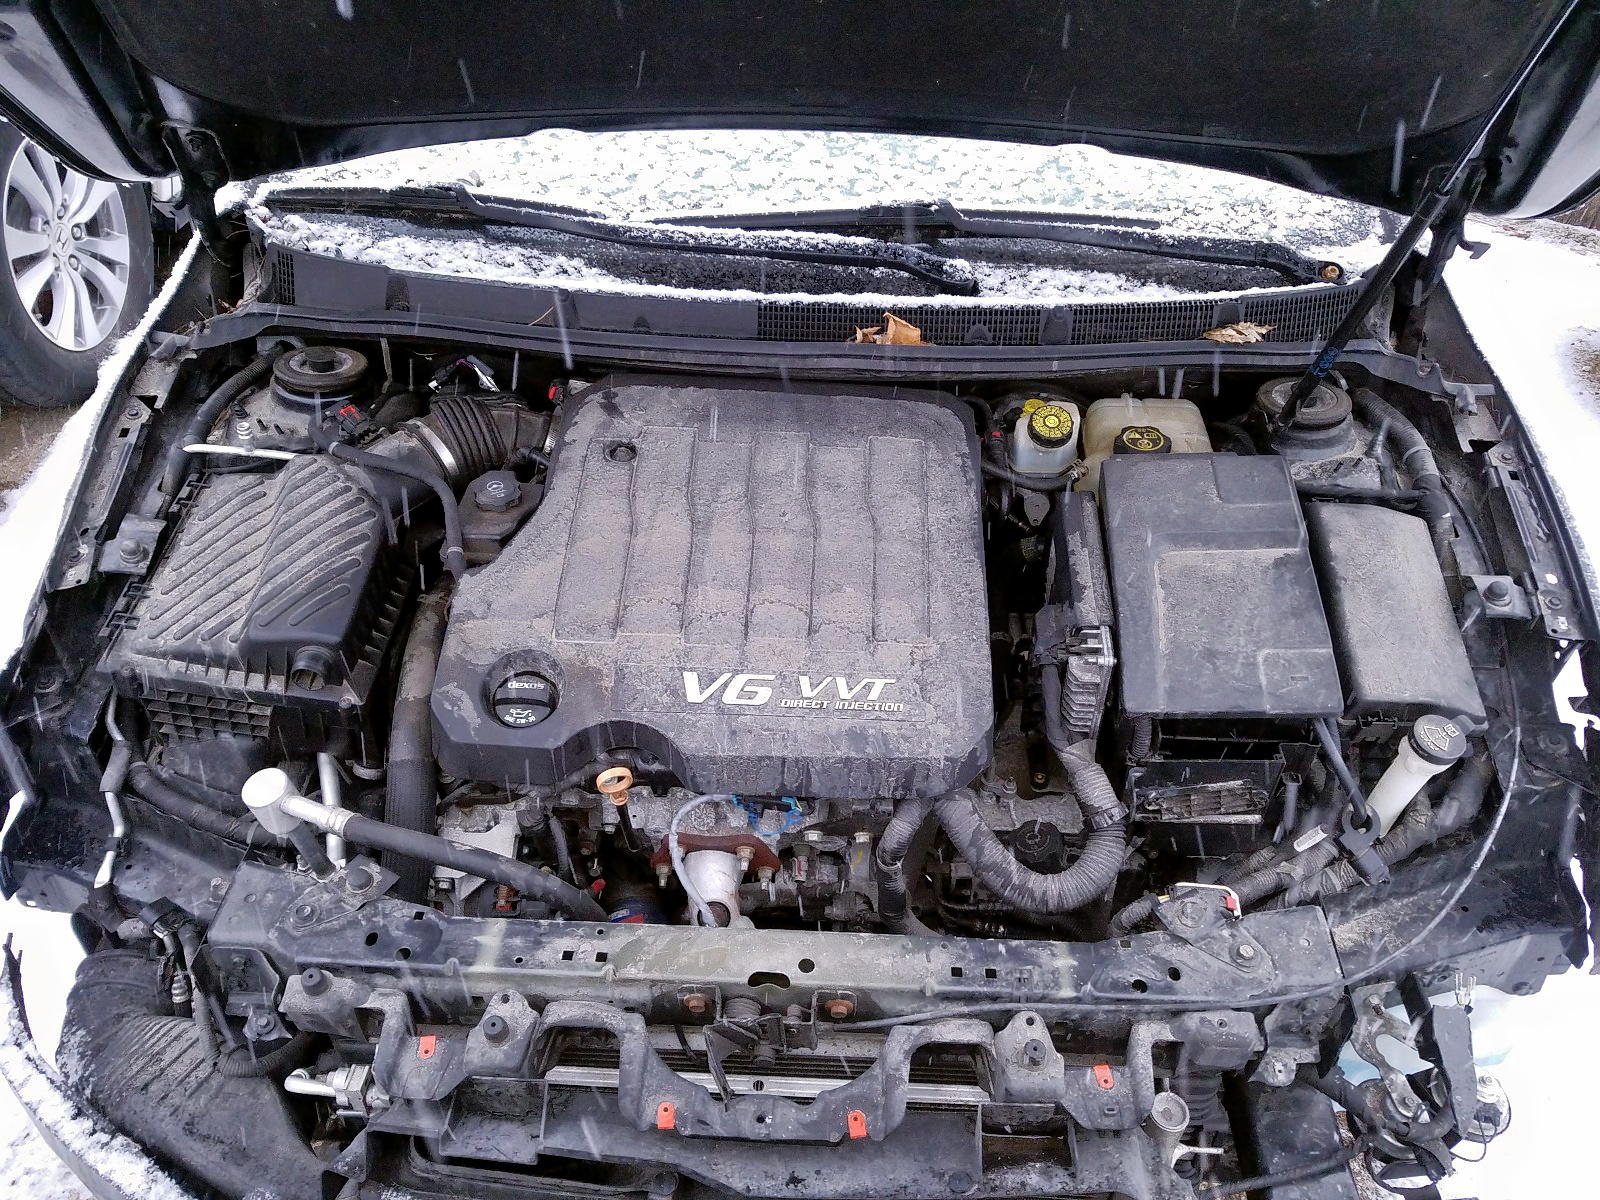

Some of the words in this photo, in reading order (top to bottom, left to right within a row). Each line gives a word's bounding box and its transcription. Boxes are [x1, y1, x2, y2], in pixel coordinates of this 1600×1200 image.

[682, 671, 776, 706] V6
[798, 675, 896, 700] VVT
[780, 699, 830, 709] DIRECT
[834, 701, 904, 712] INJECTION
